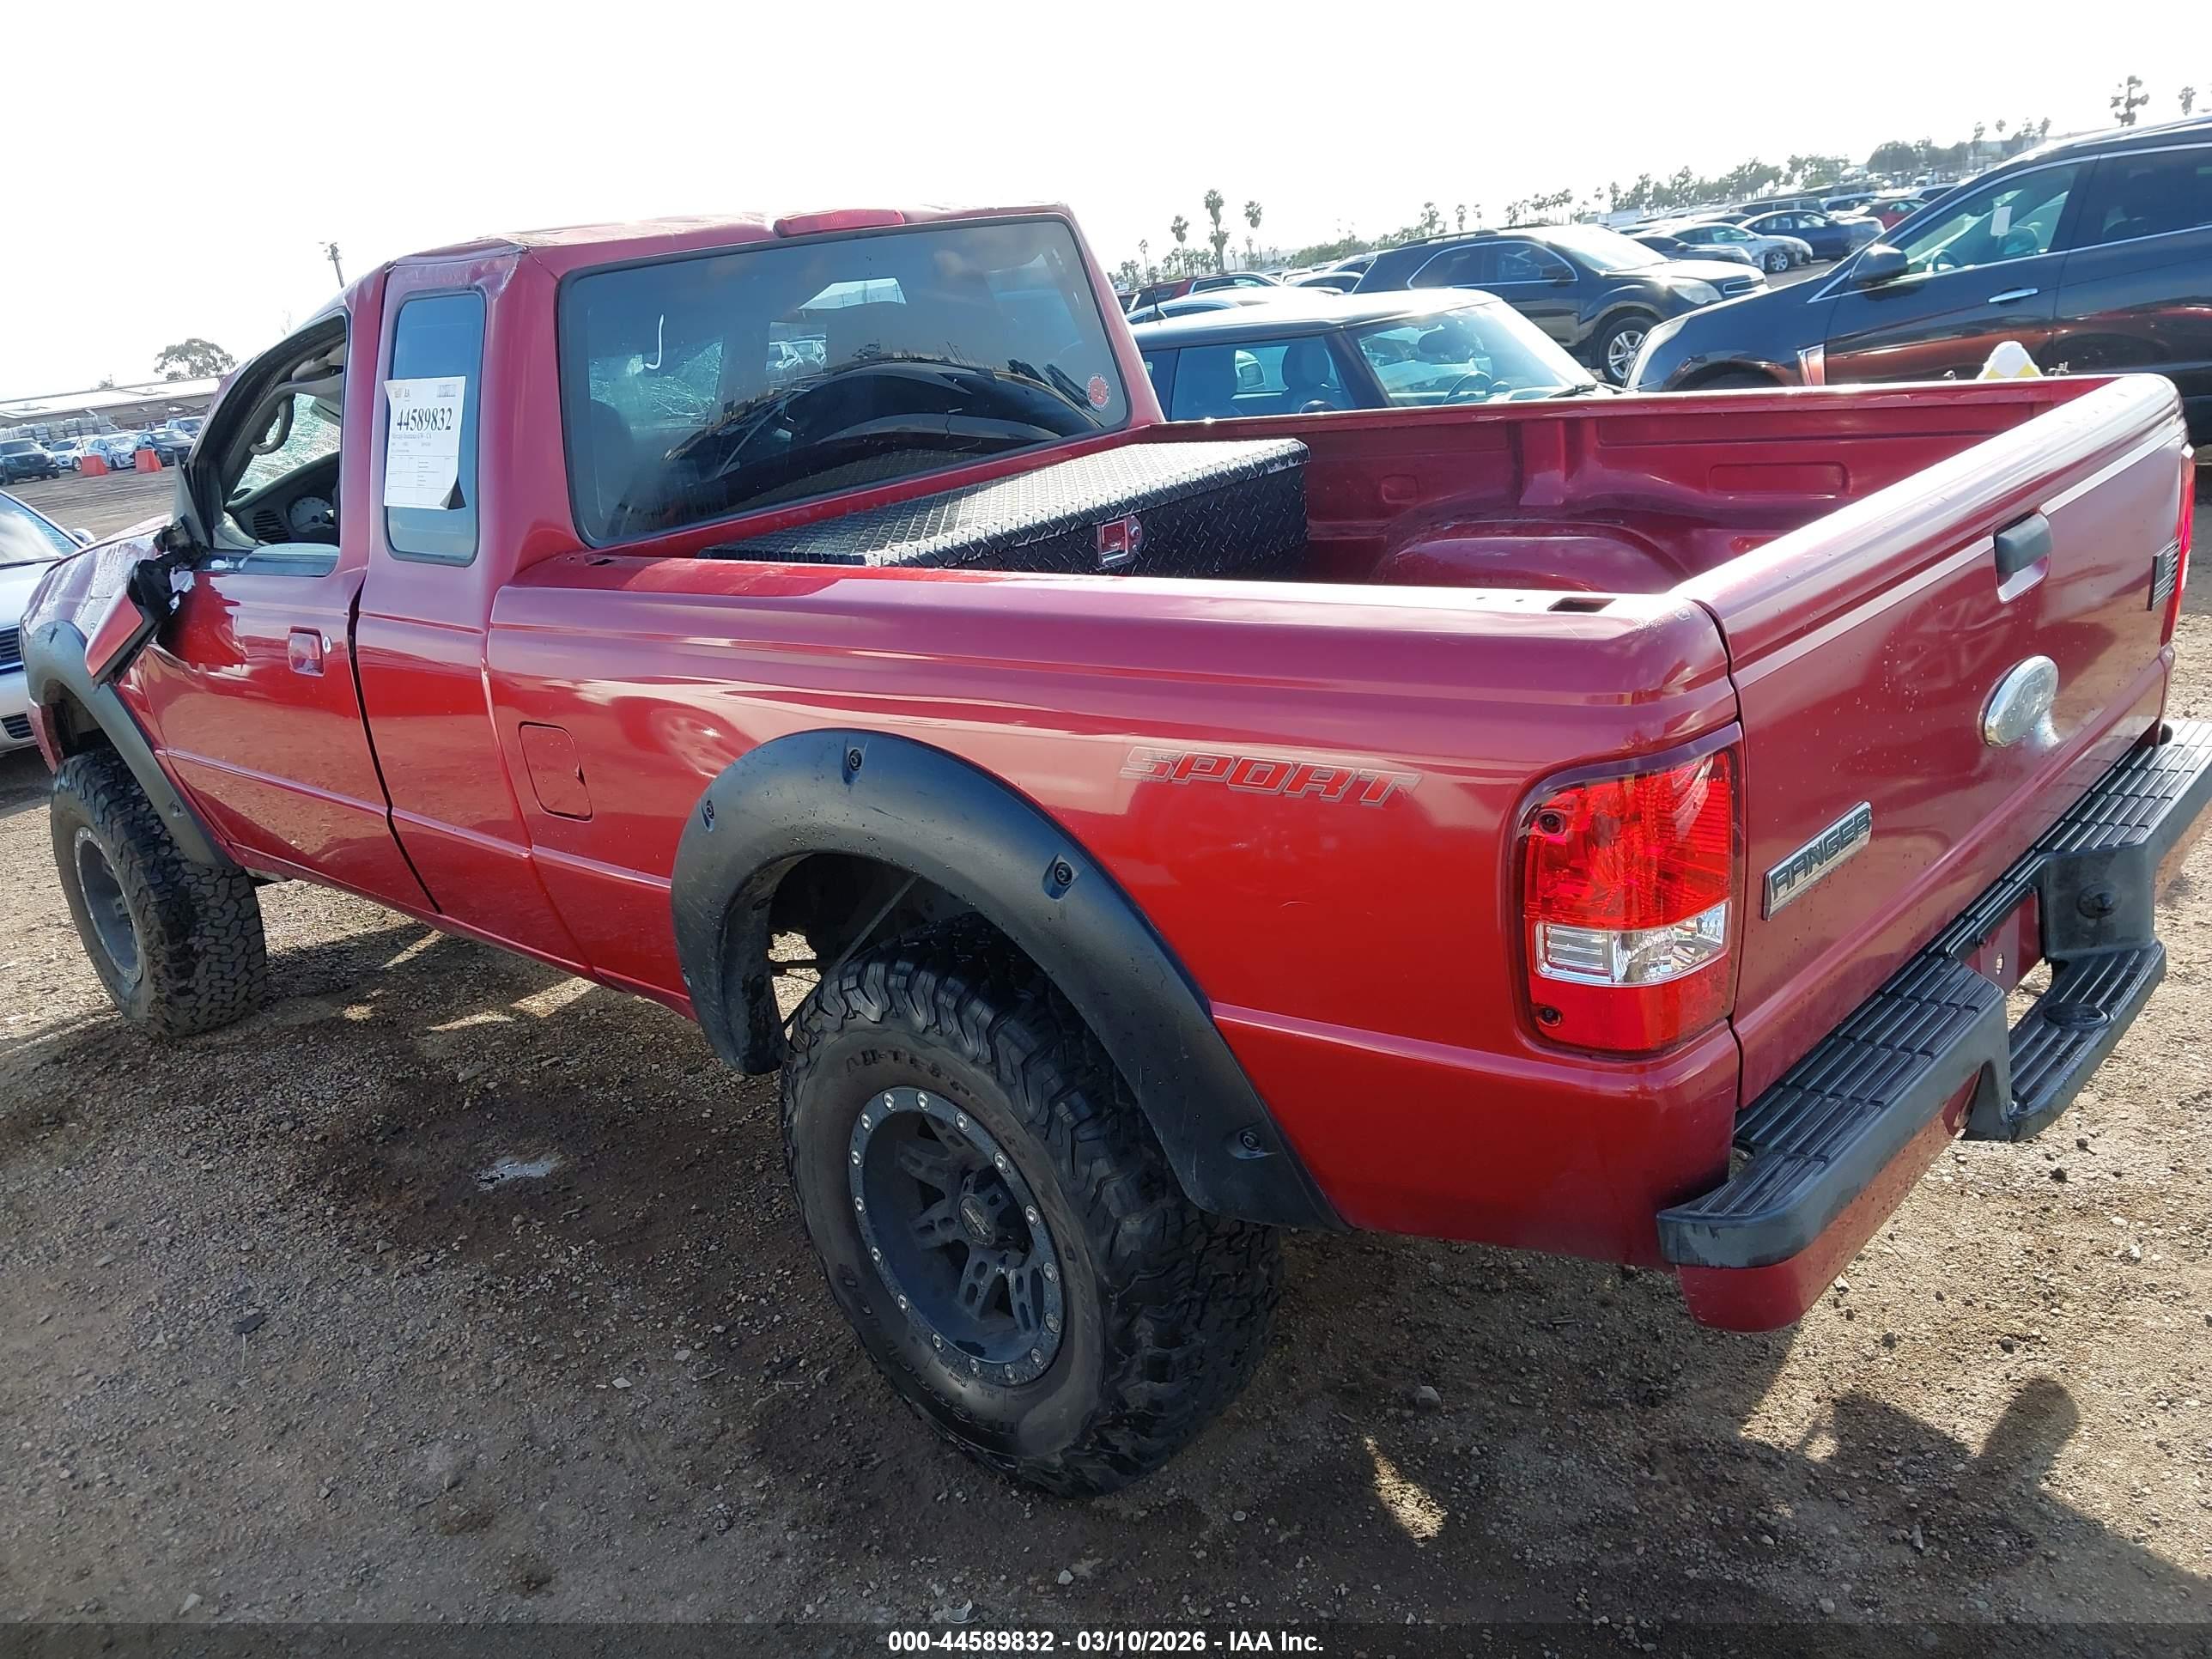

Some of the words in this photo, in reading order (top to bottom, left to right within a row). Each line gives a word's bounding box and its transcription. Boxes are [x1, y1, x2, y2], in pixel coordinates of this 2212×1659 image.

[397, 407, 453, 431] 44589832
[1120, 745, 1423, 809] SPORT
[1770, 807, 1871, 902] RANGER
